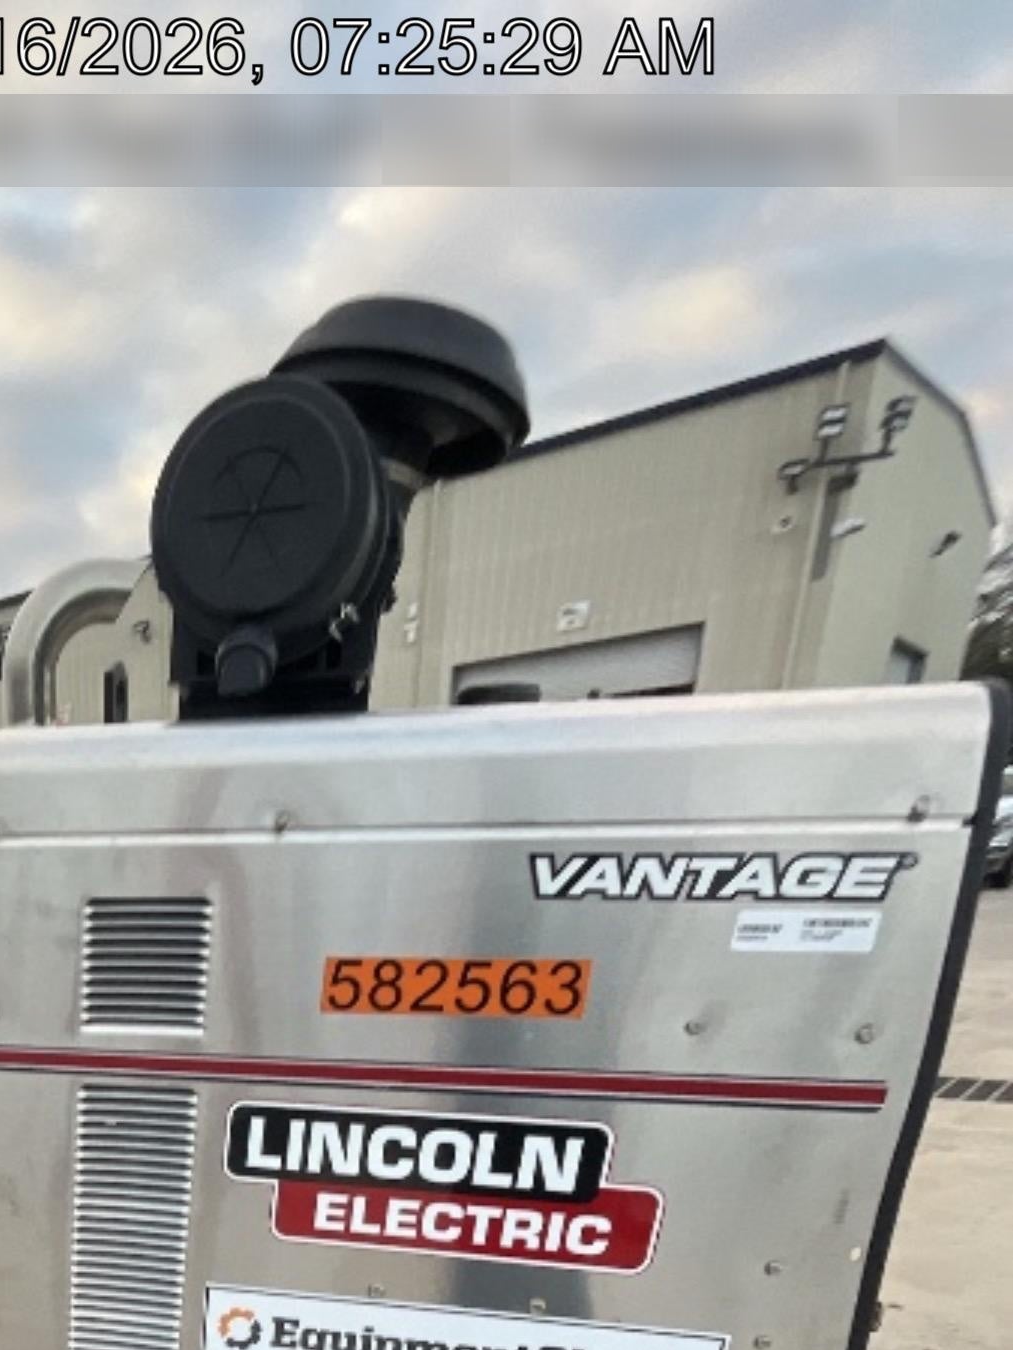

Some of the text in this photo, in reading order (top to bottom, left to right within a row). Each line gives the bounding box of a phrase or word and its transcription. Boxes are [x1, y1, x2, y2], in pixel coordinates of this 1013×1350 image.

[531, 853, 901, 900] VANTAGE
[328, 960, 582, 1015] 582563
[244, 1115, 585, 1194] LINCOLN
[313, 1193, 613, 1256] ELECTRIC
